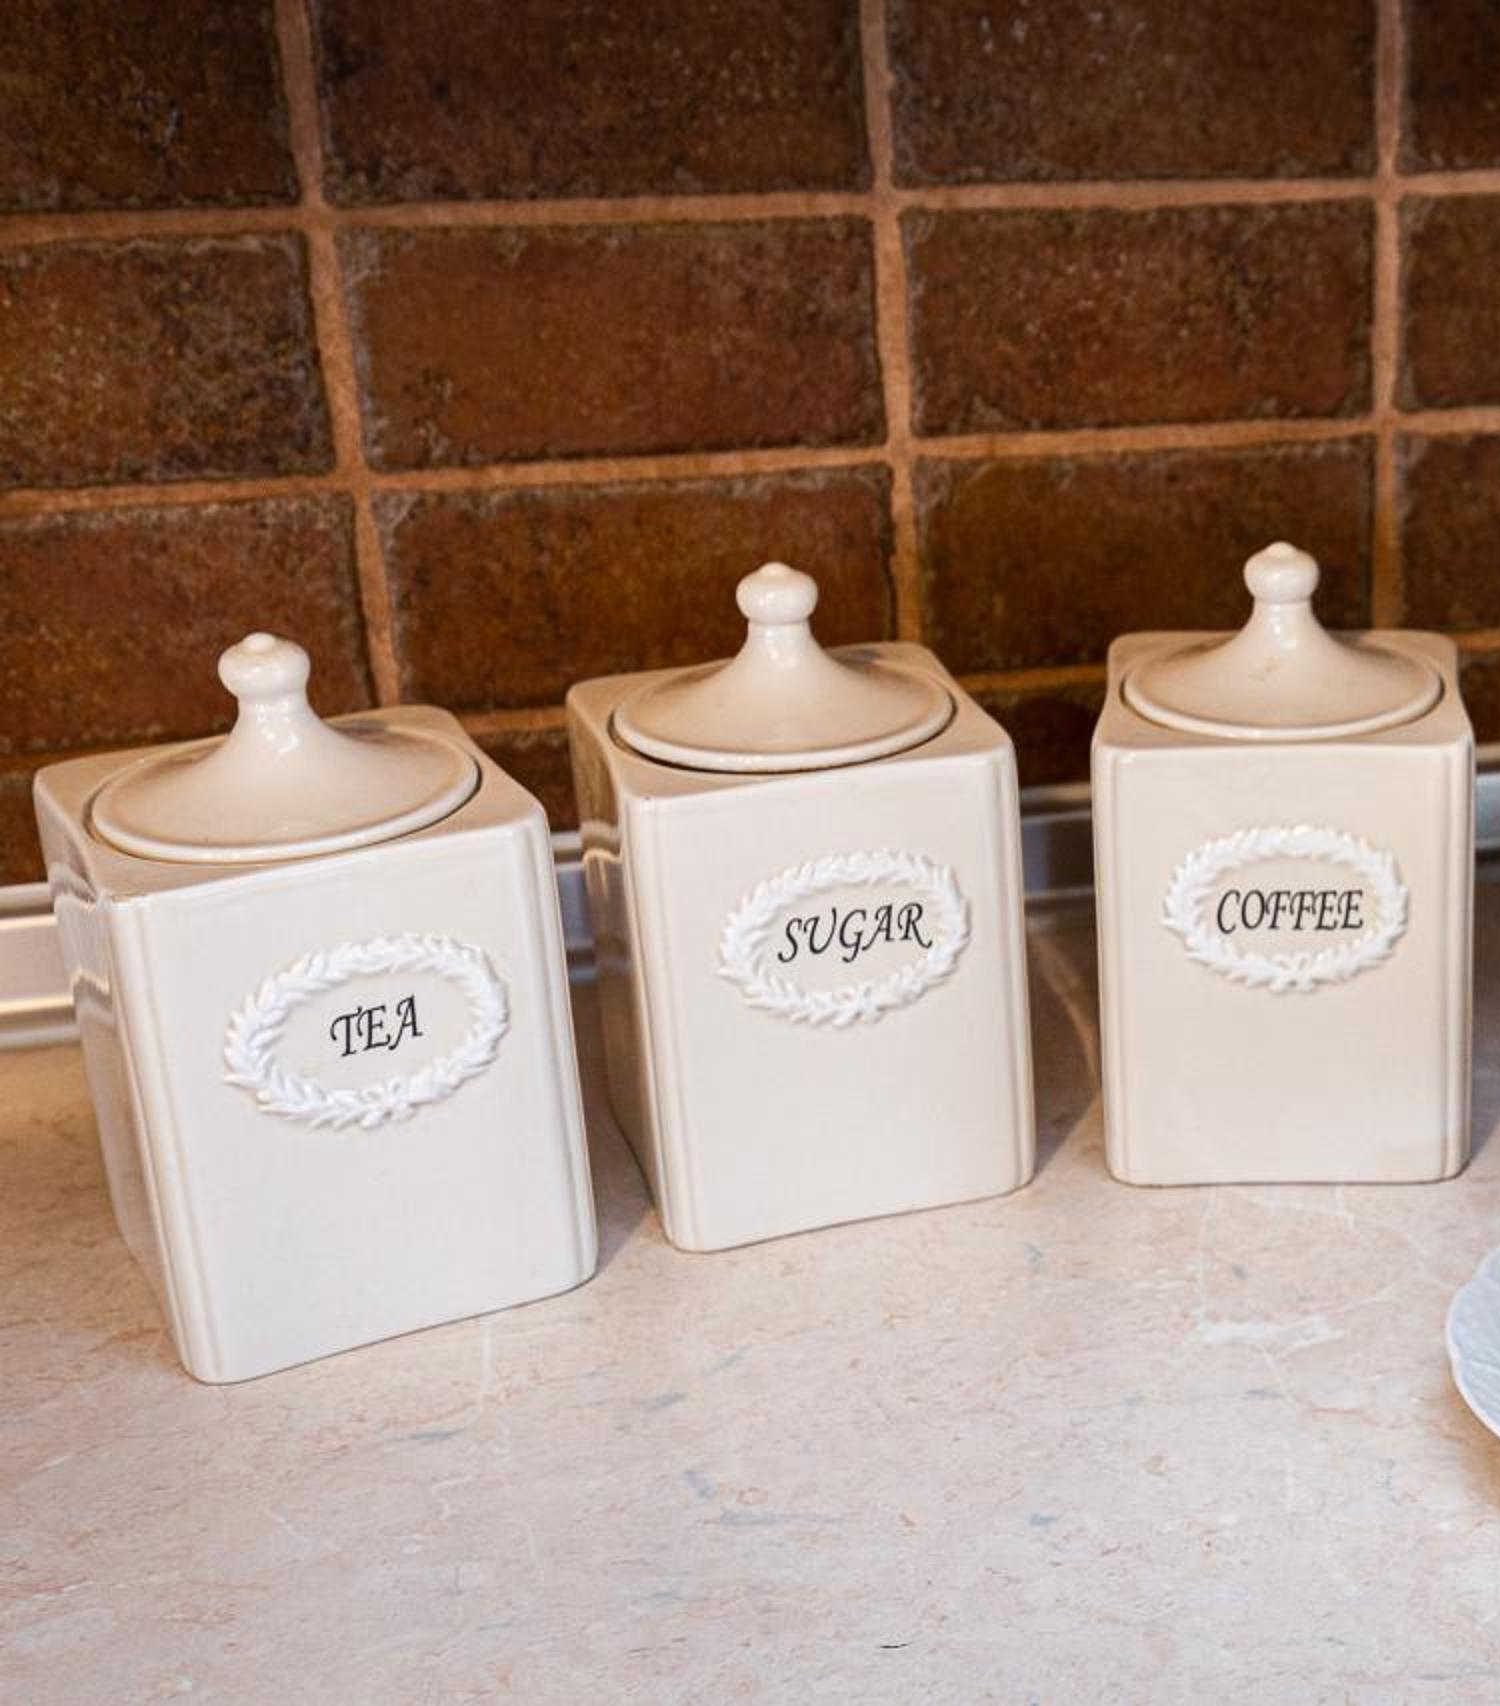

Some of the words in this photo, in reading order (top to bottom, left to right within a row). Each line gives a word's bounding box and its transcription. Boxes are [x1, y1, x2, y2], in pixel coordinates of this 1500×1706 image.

[777, 902, 933, 963] SUGAR
[1217, 889, 1364, 935] COFFEE
[329, 994, 423, 1057] TEA
